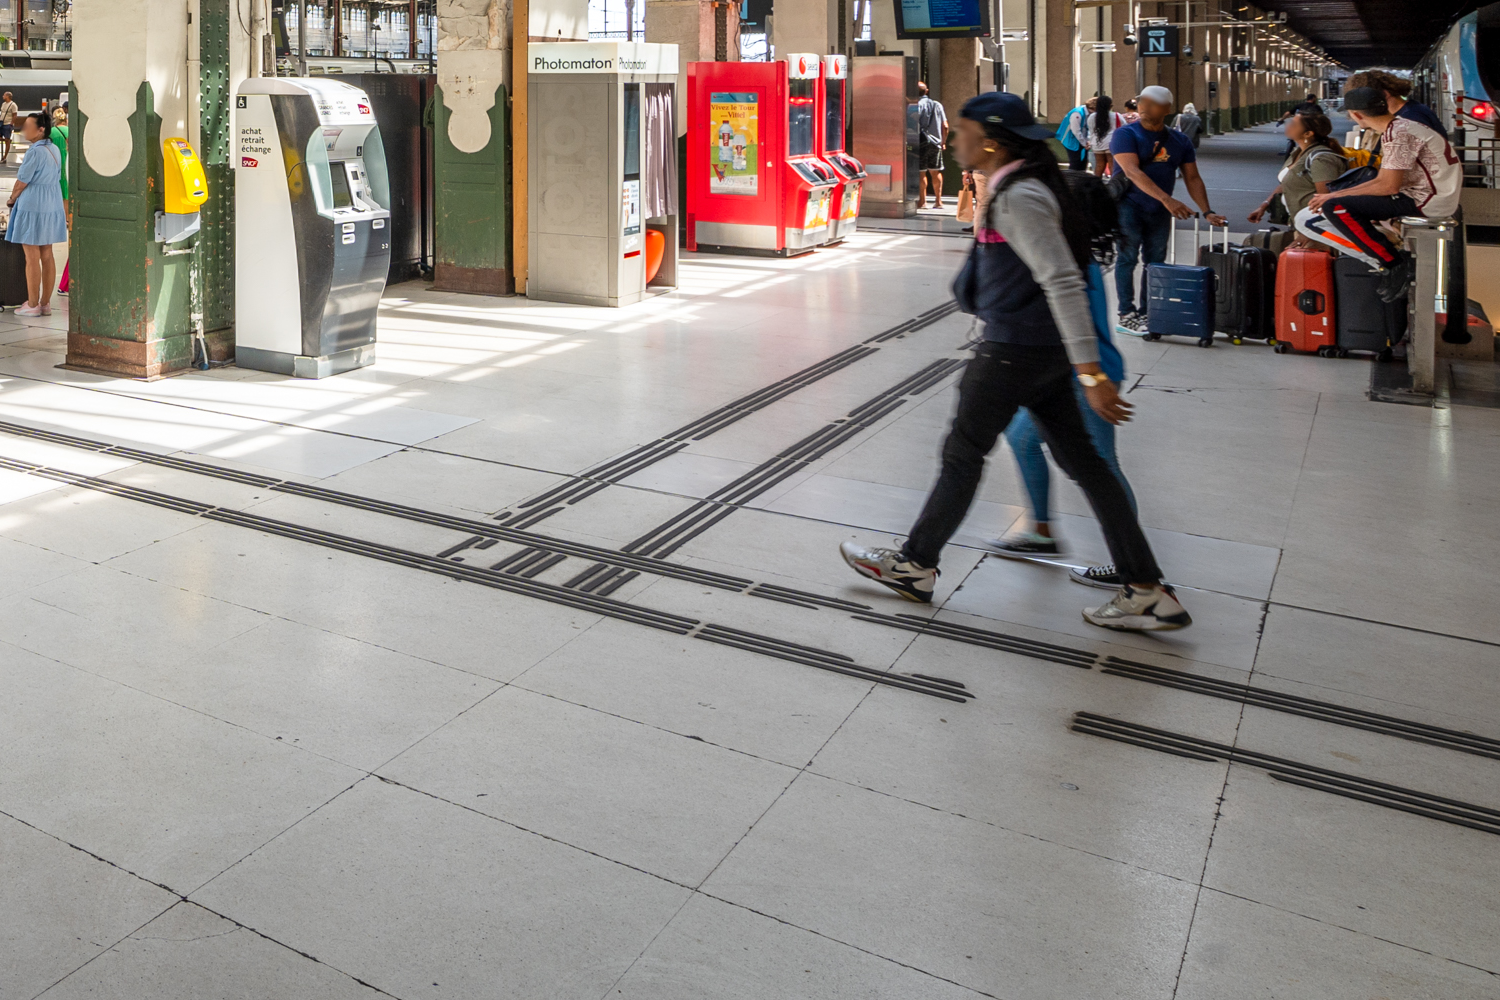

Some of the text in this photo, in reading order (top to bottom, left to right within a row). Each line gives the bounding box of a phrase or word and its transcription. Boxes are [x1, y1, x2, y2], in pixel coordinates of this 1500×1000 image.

[1149, 37, 1165, 52] N
[534, 56, 612, 70] Photomaton
[728, 111, 746, 119] Vittel
[241, 127, 262, 135] achat
[241, 136, 265, 144] retrait
[241, 145, 271, 155] échange
